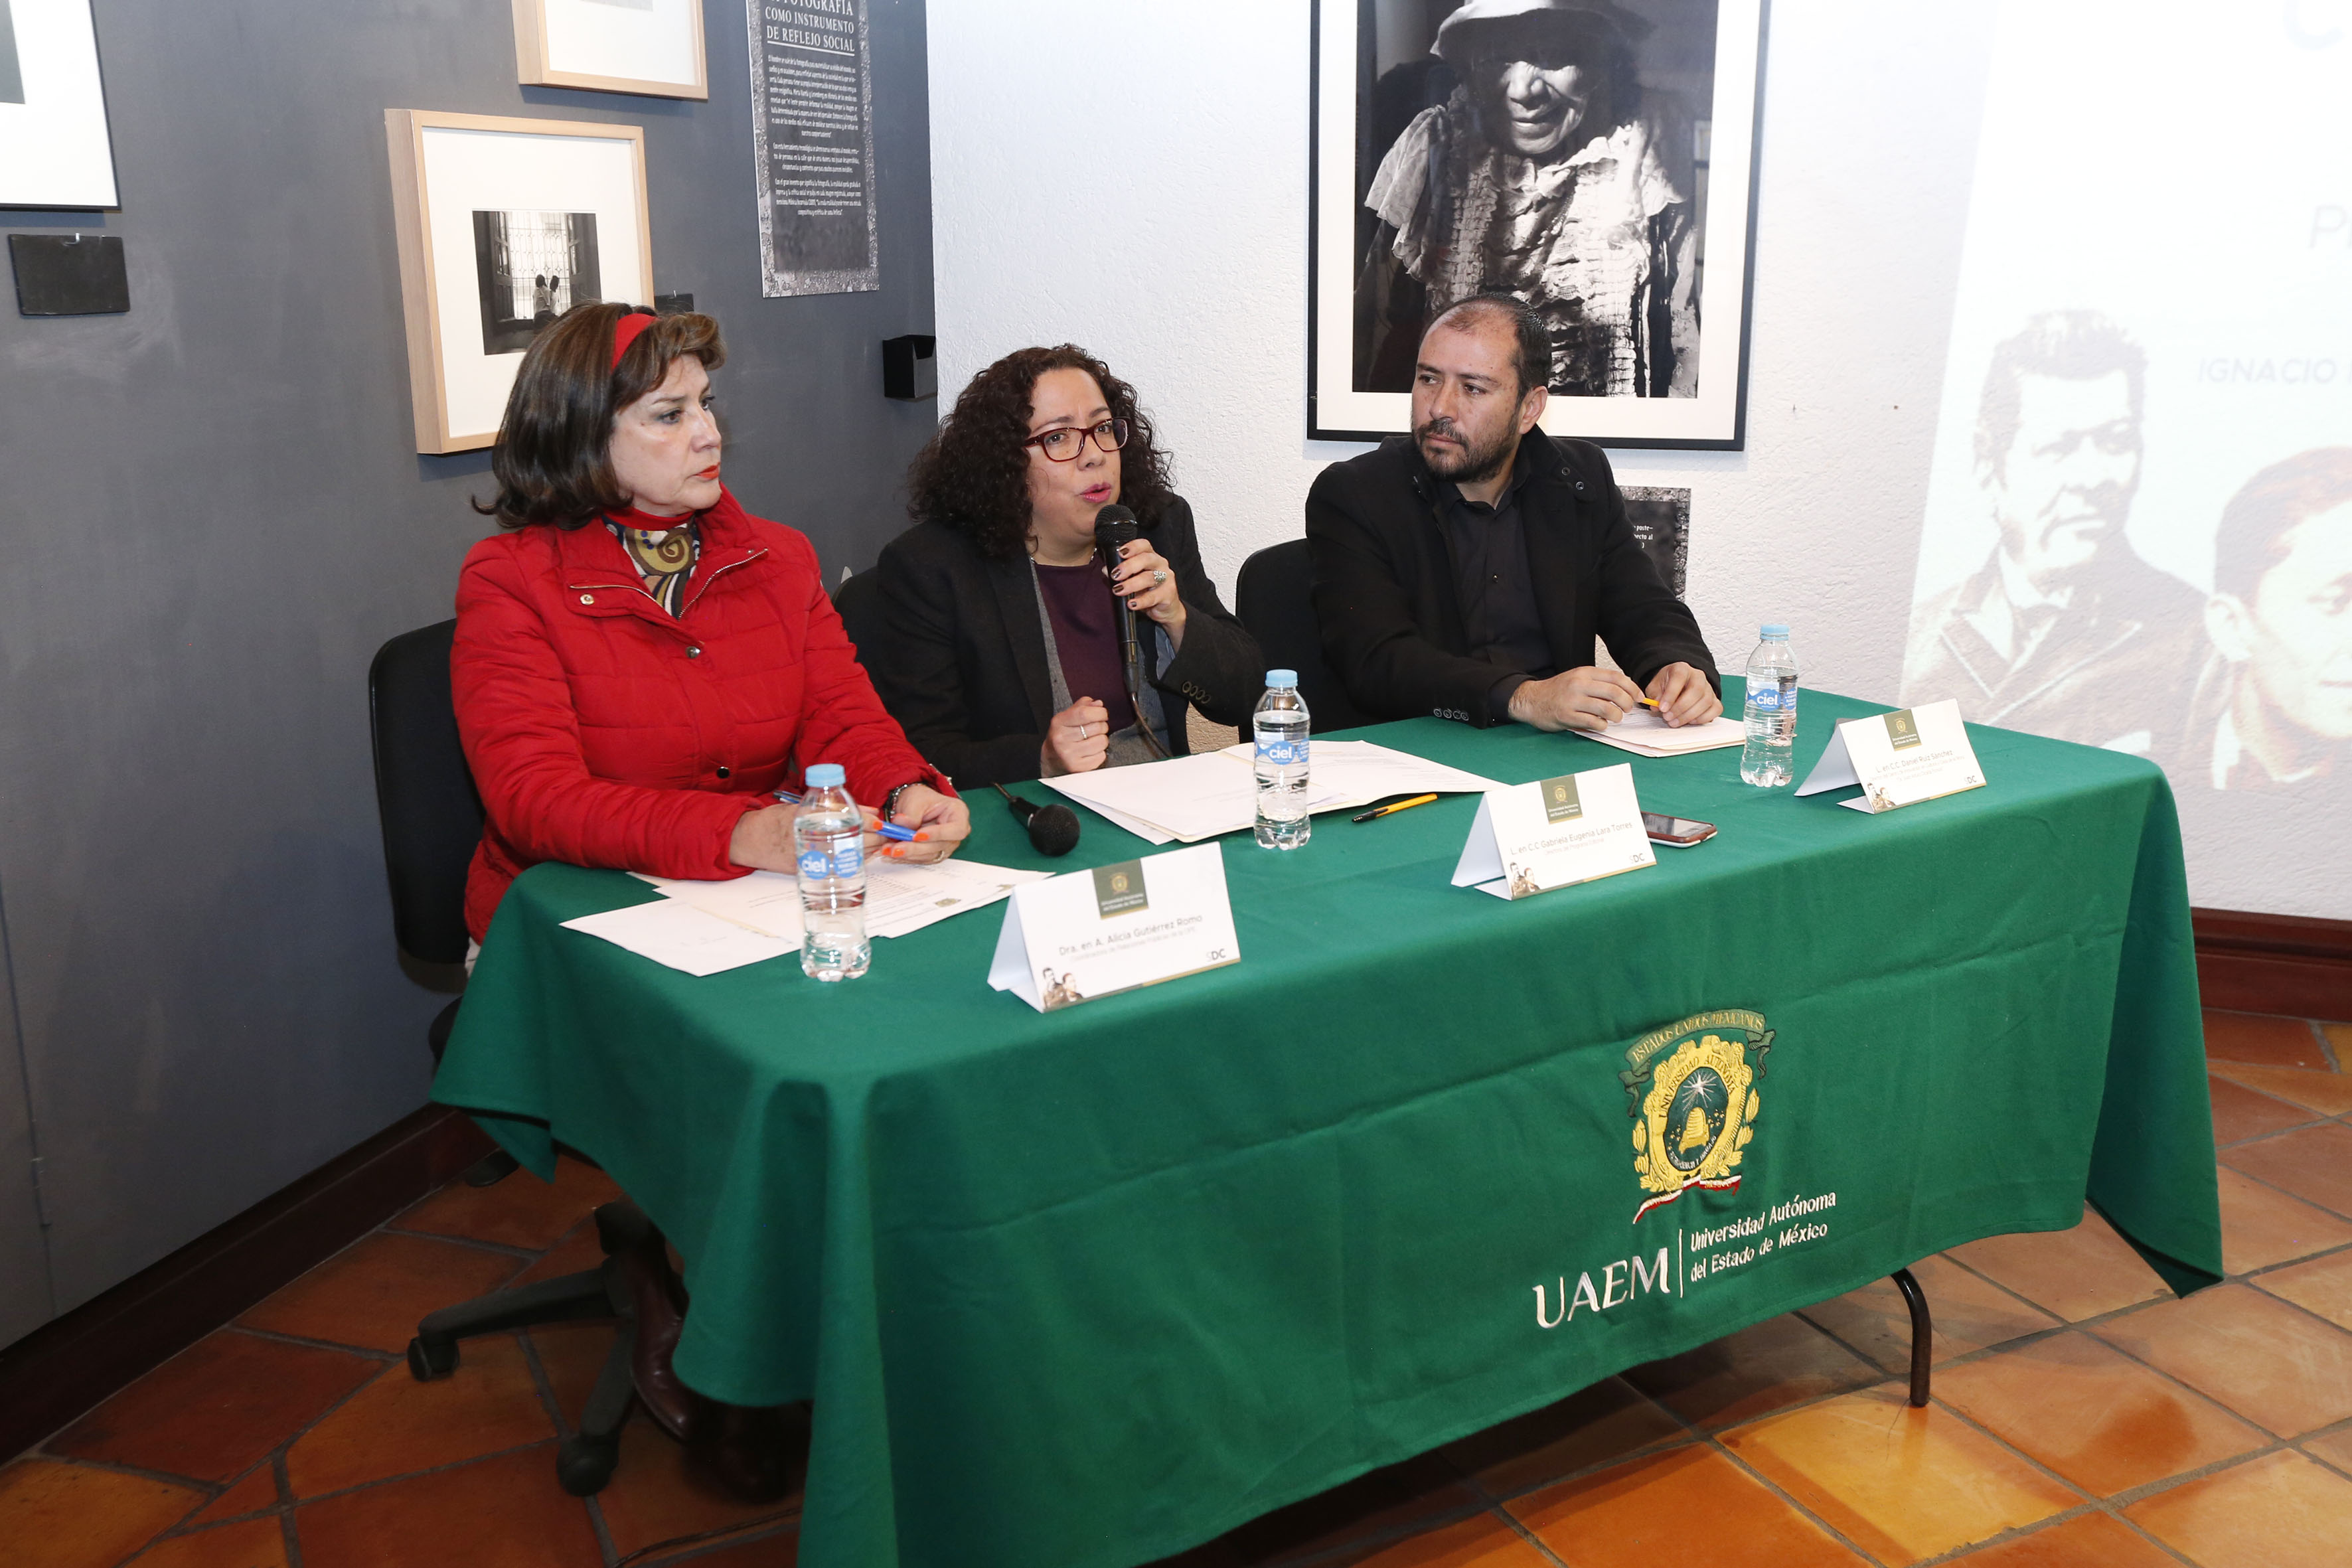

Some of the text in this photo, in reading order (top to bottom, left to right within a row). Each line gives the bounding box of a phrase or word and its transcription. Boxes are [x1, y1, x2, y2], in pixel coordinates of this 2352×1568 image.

[765, 6, 854, 34] COMO INSTRUMENTO
[767, 25, 855, 52] DE REFLEJO SOCIAL
[2197, 357, 2338, 385] IGNACIO
[1757, 692, 1779, 706] ciel
[1269, 745, 1293, 759] ciel
[1901, 758, 1918, 767] Daniel
[1541, 836, 1568, 848] Gabriela
[1569, 830, 1595, 842] Eugenia
[1596, 826, 1611, 836] Lara
[1611, 822, 1633, 832] Torres
[801, 855, 826, 872] ciel
[1059, 944, 1077, 956] Dra.
[1081, 941, 1092, 951] en
[1095, 937, 1103, 947] A.
[1107, 931, 1131, 944] Alicia
[1133, 921, 1174, 937] Gutiérrez
[1176, 914, 1203, 926] Romo
[1206, 948, 1226, 962] SDC
[1632, 1030, 1674, 1062] ESTADOS
[1711, 1012, 1764, 1031] MEXICANOS
[1658, 1056, 1699, 1118] UNIVERSIDAD
[1691, 1192, 1837, 1253] Universidad Autónoma
[1691, 1222, 1829, 1283] del Estado de México
[1532, 1247, 1670, 1328] UAEM
